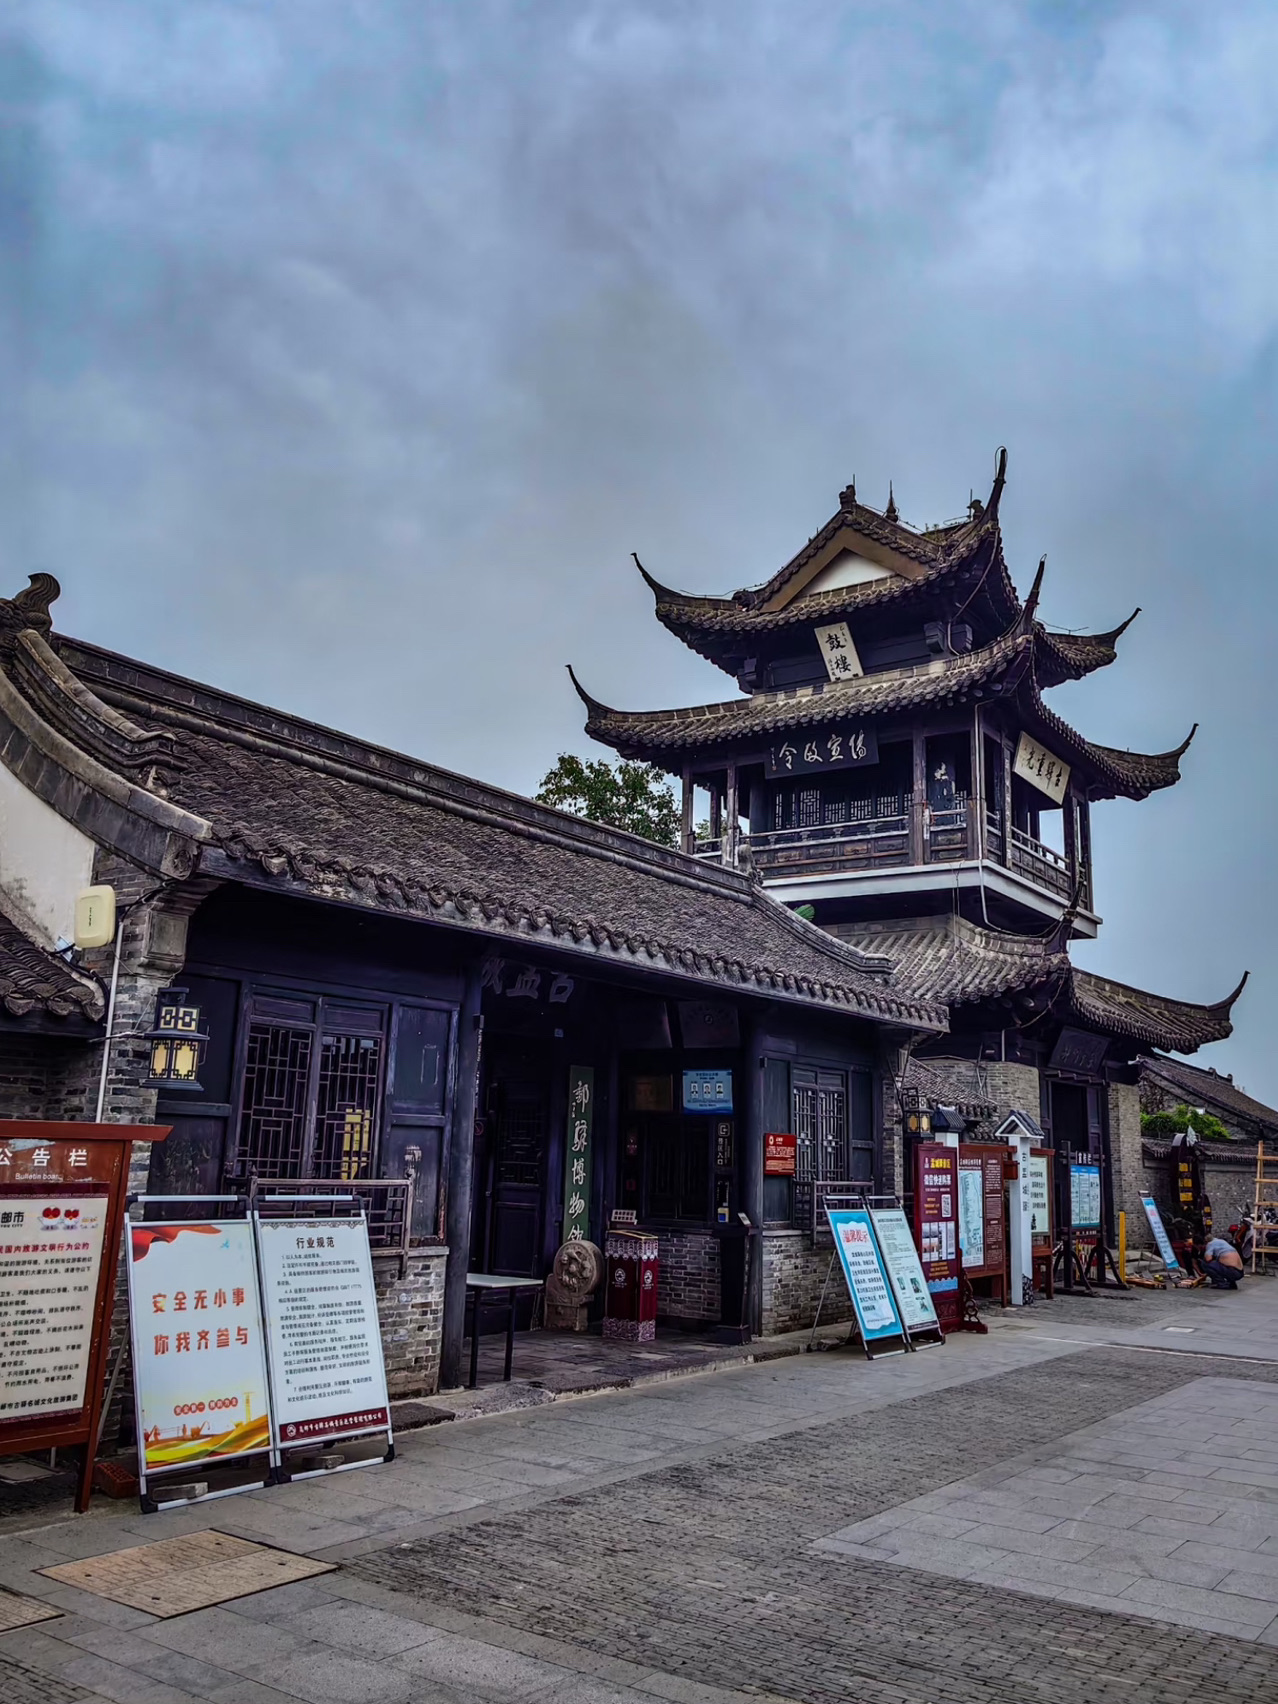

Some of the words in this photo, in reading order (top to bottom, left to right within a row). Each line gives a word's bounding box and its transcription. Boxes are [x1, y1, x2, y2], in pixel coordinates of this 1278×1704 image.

[0, 1148, 88, 1167] 公告栏
[15, 1172, 41, 1180] Bulletin
[296, 1236, 335, 1249] 行业规范
[152, 1287, 245, 1314] 安全无小事
